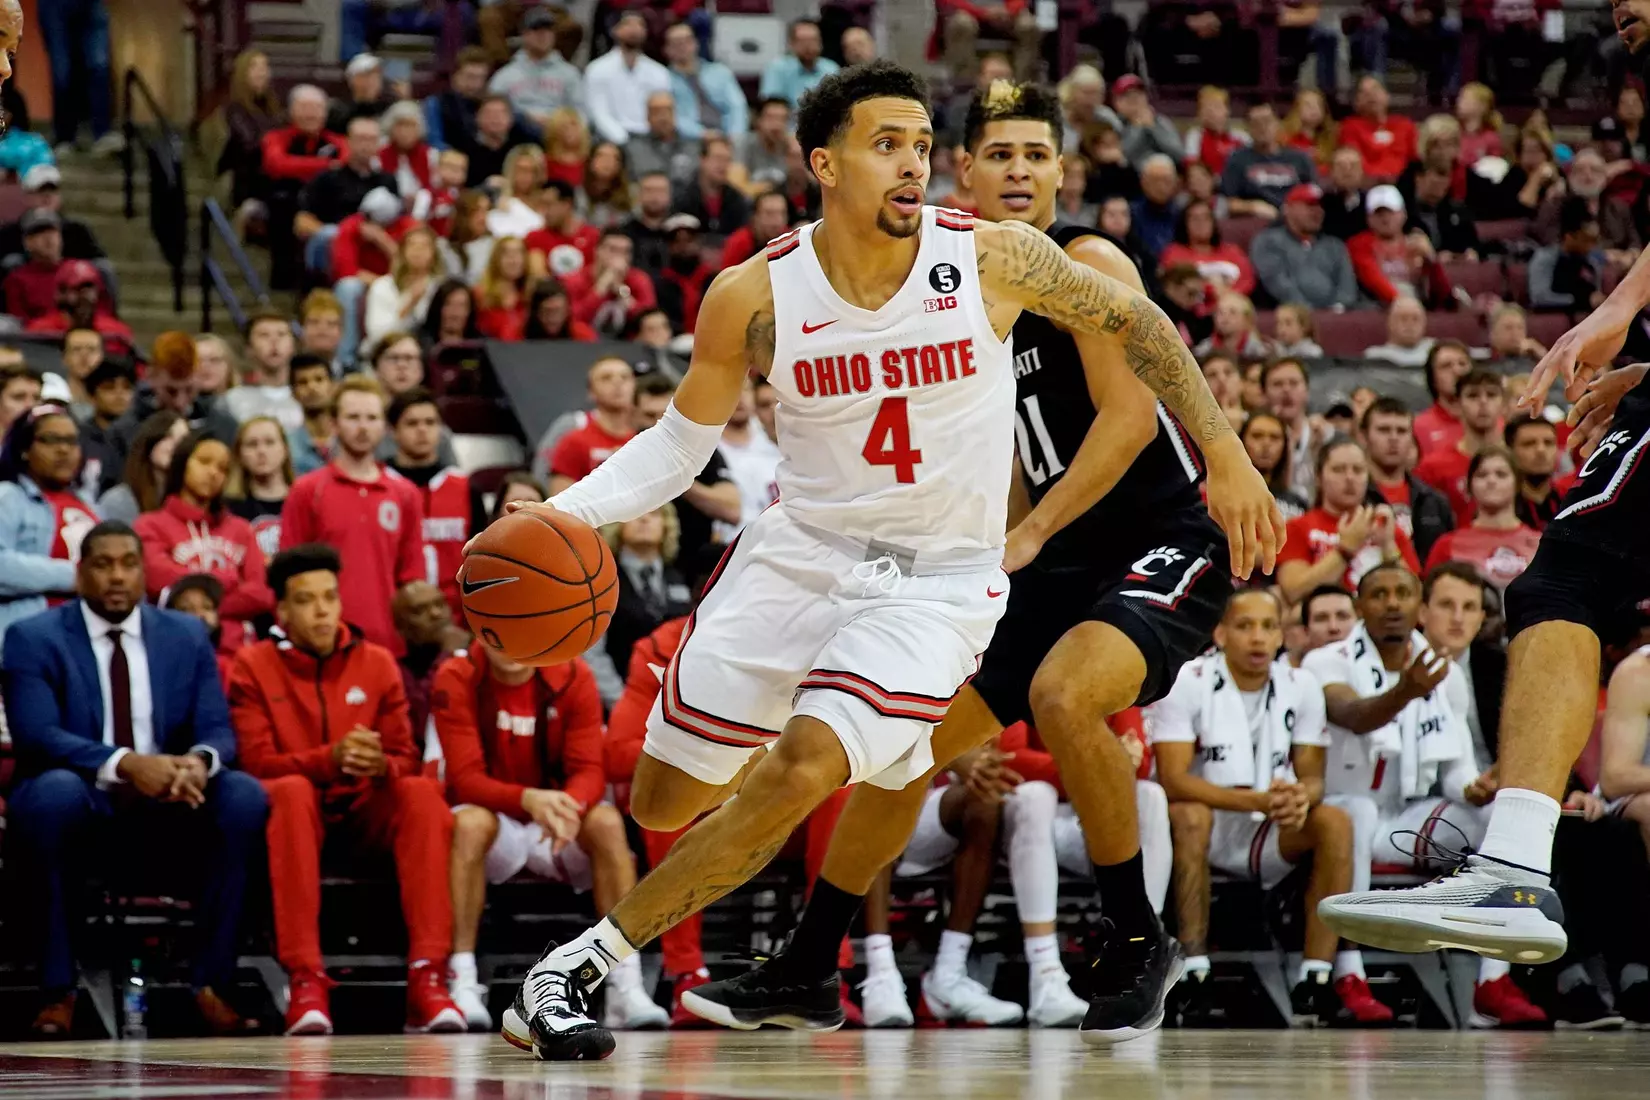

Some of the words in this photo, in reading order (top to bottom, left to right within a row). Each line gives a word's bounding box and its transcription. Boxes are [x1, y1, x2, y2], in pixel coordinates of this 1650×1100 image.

[937, 270, 954, 291] 5
[792, 352, 872, 398] OHIO
[879, 337, 977, 390] STATE
[1013, 346, 1042, 379] ATI
[861, 396, 923, 484] 4
